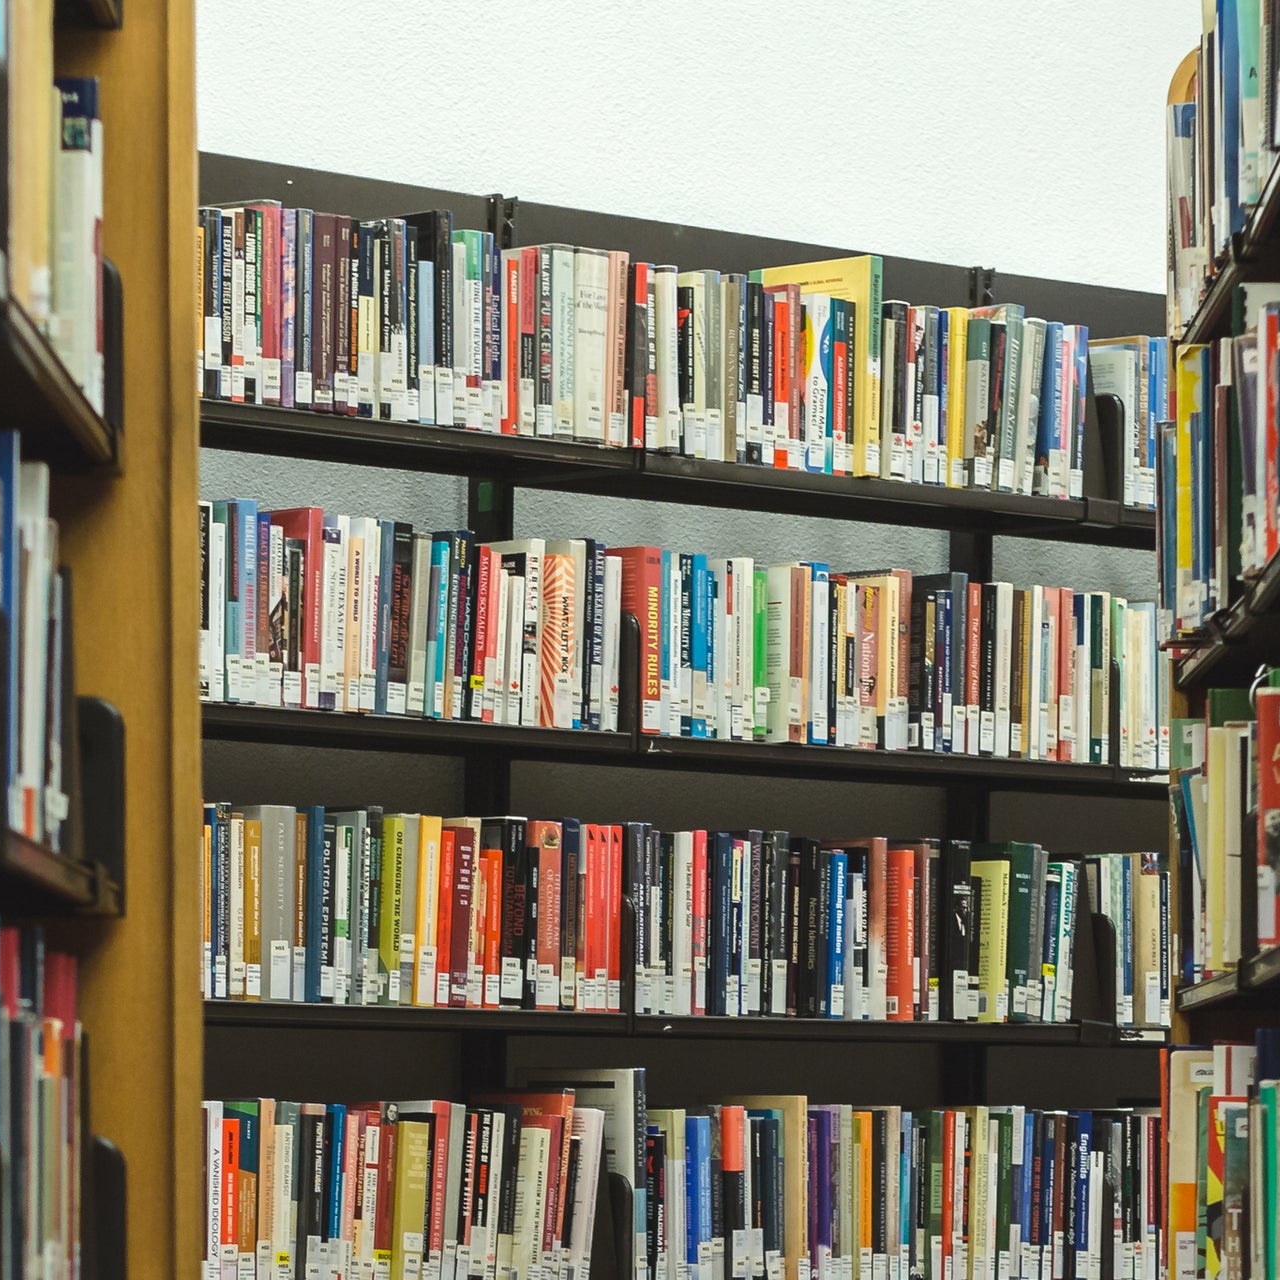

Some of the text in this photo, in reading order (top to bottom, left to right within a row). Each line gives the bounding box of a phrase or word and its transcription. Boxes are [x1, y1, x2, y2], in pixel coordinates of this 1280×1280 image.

[223, 225, 231, 342] THE EXPO FILES STIEG LARSSON
[245, 233, 256, 319] LIVING INSIDE OUR
[352, 259, 360, 272] The
[352, 273, 360, 296] Politics
[542, 253, 550, 297] BILL AYERS
[352, 297, 360, 308] of
[352, 308, 360, 354] Authoritarian
[382, 269, 391, 352] Making sense of tyranny
[492, 295, 501, 363] Radical Right
[648, 294, 656, 371] HAMMER of the
[872, 274, 880, 363] Separatist Movements
[542, 300, 551, 381] PUBLIC ENEMY
[837, 356, 845, 390] AGAINST
[812, 376, 819, 387] to
[819, 389, 827, 441] From Marx
[1140, 378, 1149, 413] RABBI
[246, 515, 256, 569] MICHAEL KAZIN
[260, 521, 270, 557] LEGACY
[260, 560, 270, 573] TO
[246, 583, 256, 661] AMERICAN DREAMERS
[338, 566, 346, 650] THE TEXAS LEFT
[354, 583, 361, 593] TO
[449, 573, 459, 671] RENEWING SOCIALISM
[594, 550, 604, 664] LAXER IN SEARCH OF A NEW
[648, 586, 659, 696] MINORITY RULES
[682, 591, 690, 661] THE MORALITY OF
[970, 617, 980, 680] The Antiquity of
[862, 631, 875, 703] Nationalism
[322, 840, 331, 902] POLITICAL
[394, 832, 403, 952] ON CHANGING THE WORLD
[752, 845, 761, 950] WILSONIAN MOMENT
[1064, 871, 1074, 938] Malcolm X
[506, 865, 515, 955] TOTALITARIANISM
[516, 884, 526, 936] BEYOND
[546, 869, 554, 950] OF COMMUNISM
[809, 897, 818, 970] Nested Identities
[836, 862, 845, 954] reclaiming the nation
[1080, 1133, 1089, 1180] Englands
[212, 1148, 221, 1258] A VANISHED IDEOLOGY
